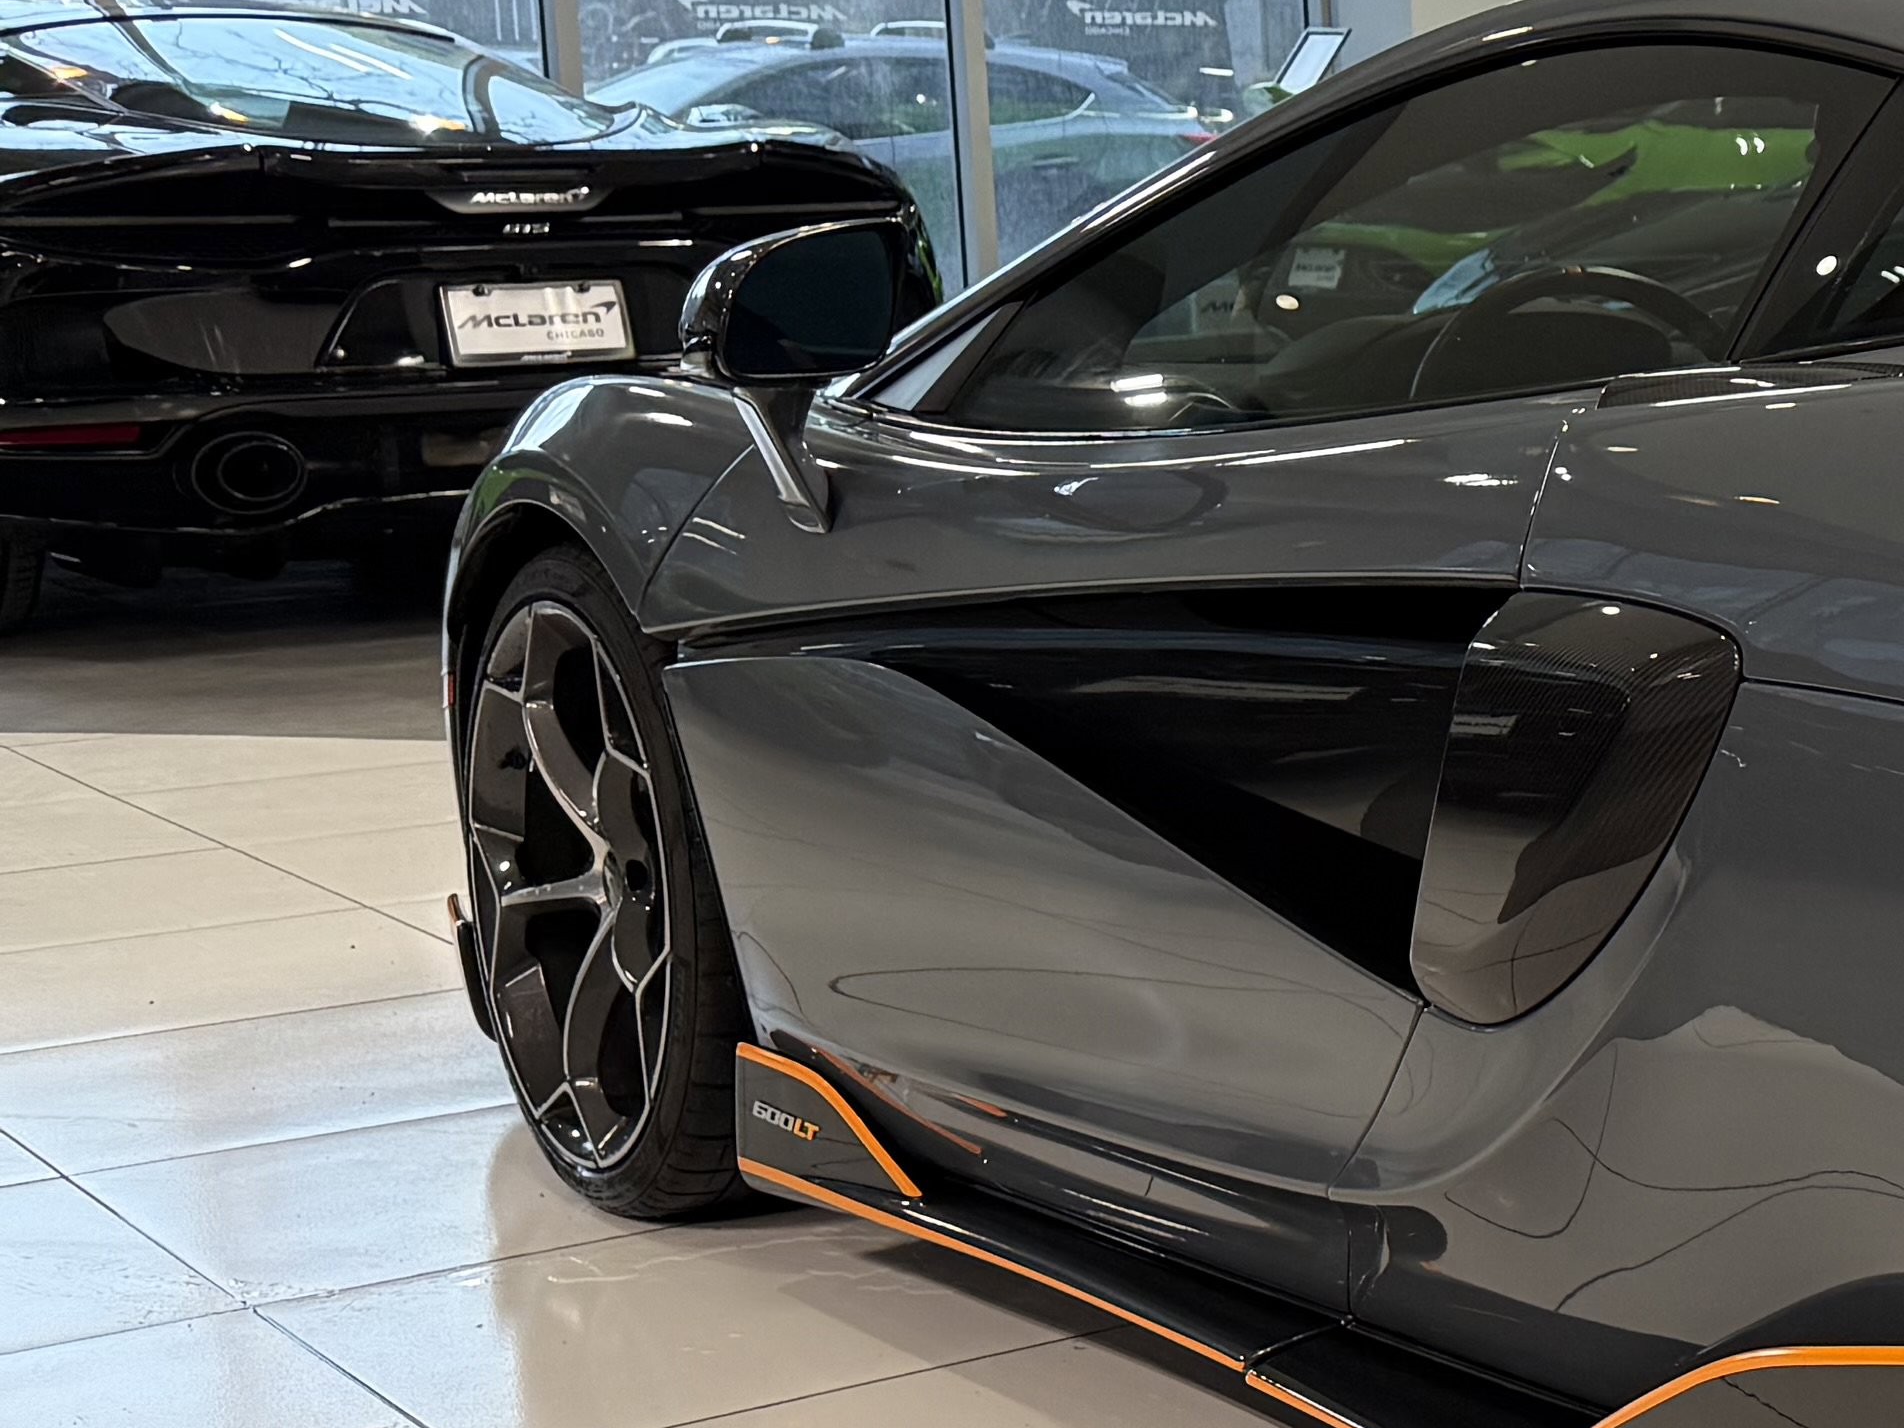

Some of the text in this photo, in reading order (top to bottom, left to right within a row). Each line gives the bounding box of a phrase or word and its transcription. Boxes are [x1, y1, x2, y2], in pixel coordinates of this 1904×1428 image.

[470, 191, 575, 204] McLaren
[457, 311, 602, 330] McLaren
[546, 328, 605, 341] CHICAGO
[752, 1100, 820, 1141] 600LT
